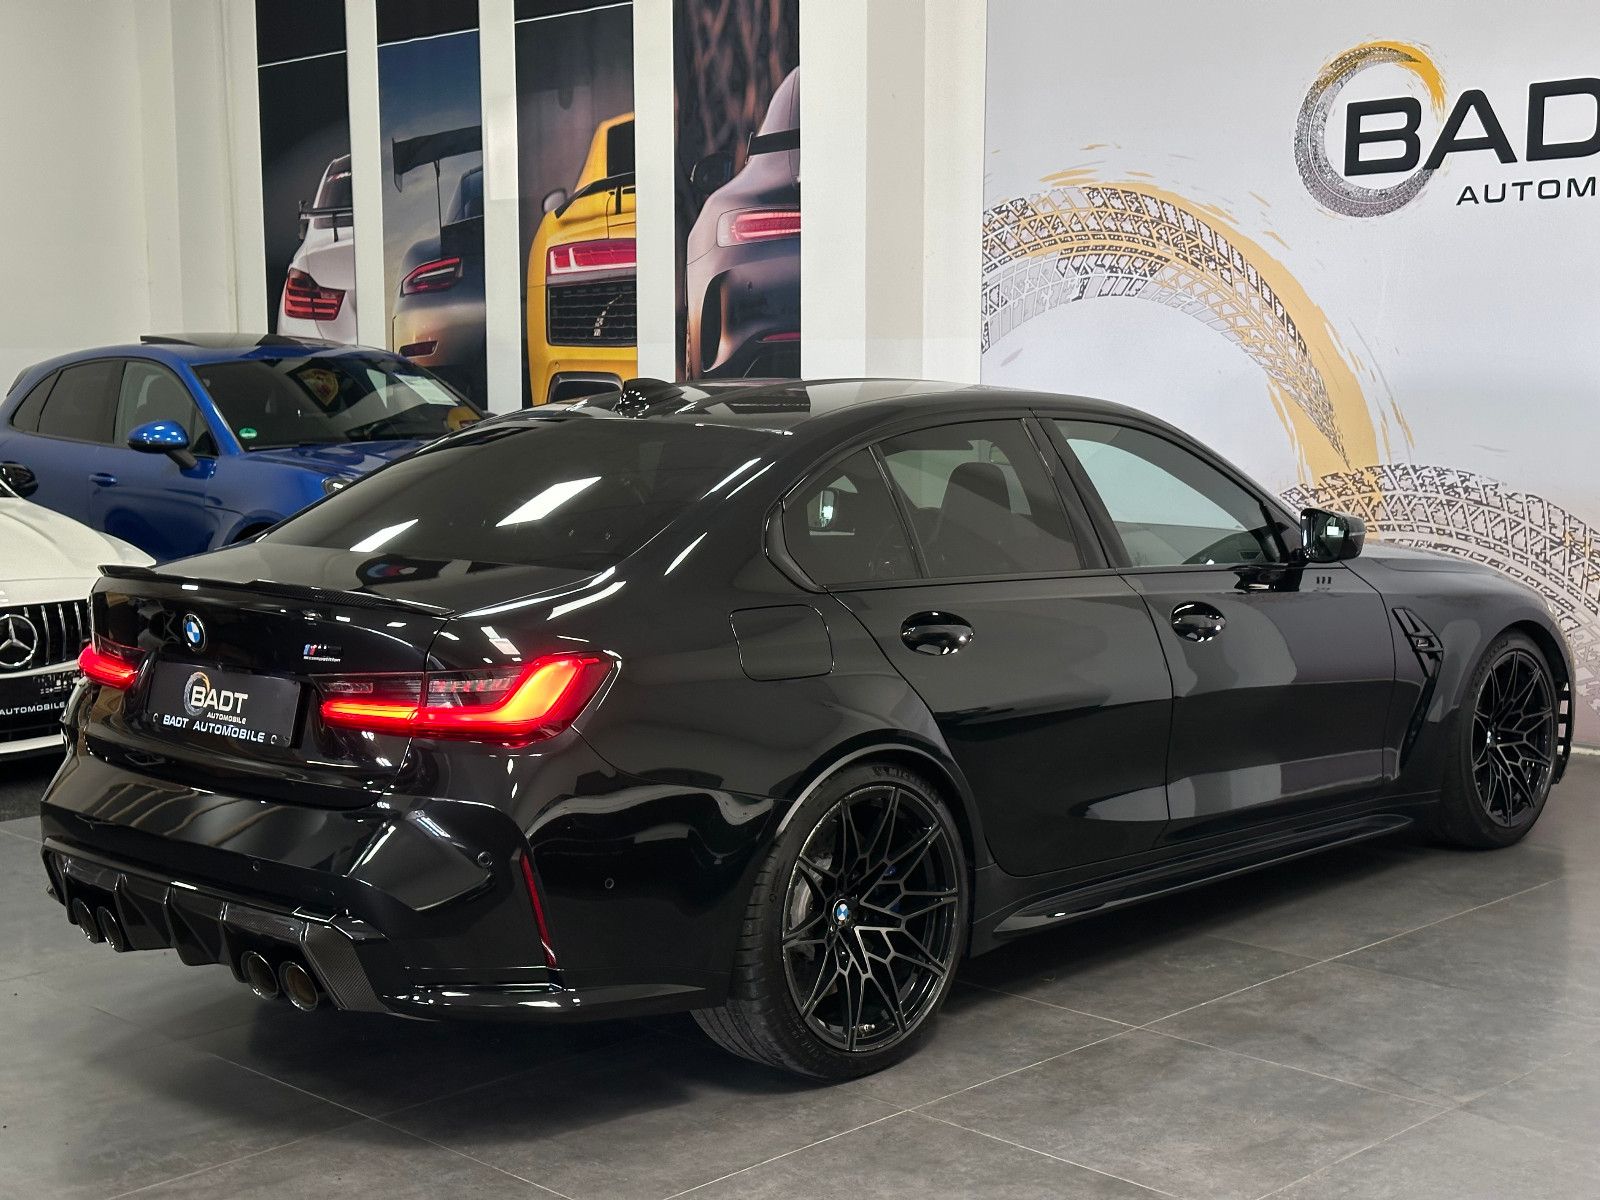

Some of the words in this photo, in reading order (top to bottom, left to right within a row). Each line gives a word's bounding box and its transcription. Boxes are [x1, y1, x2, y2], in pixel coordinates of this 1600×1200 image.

[1344, 77, 1600, 177] BAD
[1456, 176, 1597, 206] AUTOM
[0, 701, 65, 716] AUTOMOBILE
[191, 685, 249, 714] BADT
[163, 714, 189, 729] BADT
[193, 720, 266, 743] AUTOMOBILE
